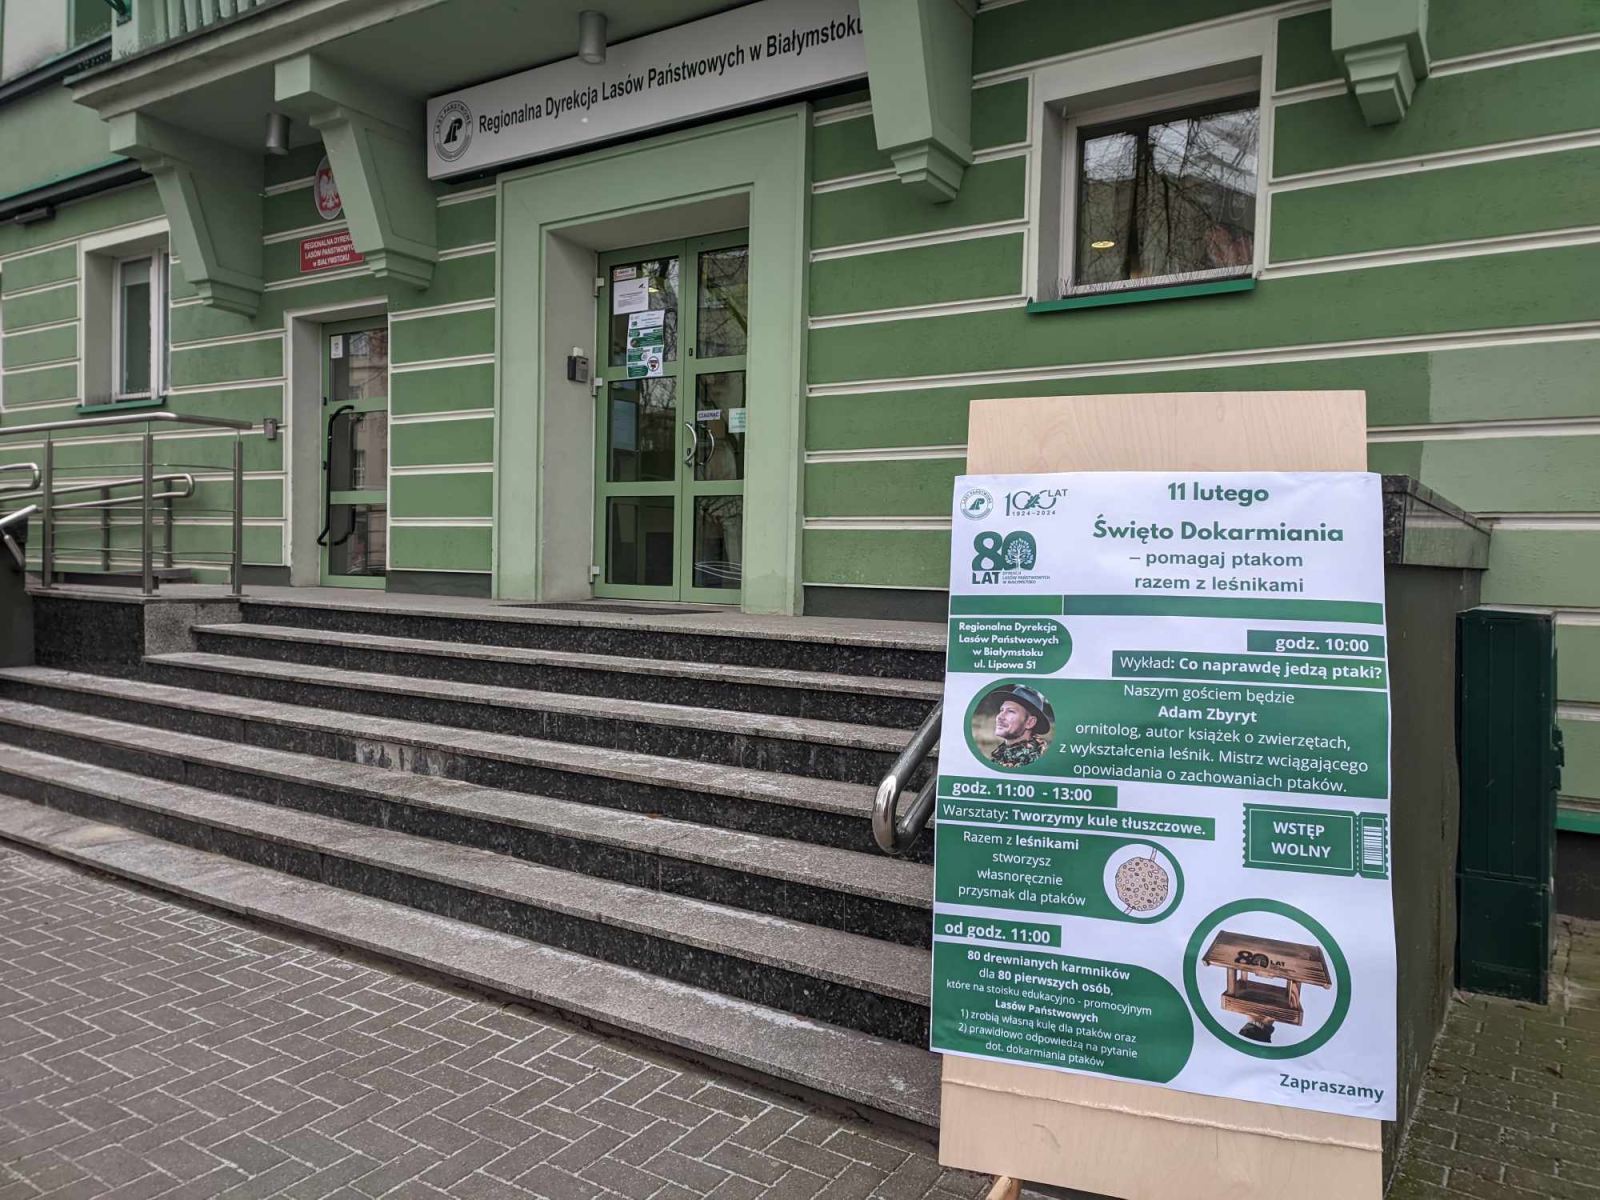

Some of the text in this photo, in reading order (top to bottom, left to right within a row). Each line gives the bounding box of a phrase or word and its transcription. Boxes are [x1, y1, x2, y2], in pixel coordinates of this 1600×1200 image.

[479, 104, 542, 134] Regionalna
[546, 86, 598, 118] Dyrekcja
[602, 73, 644, 101] Lasów
[648, 45, 744, 89] Państwowych
[749, 44, 762, 61] w
[1047, 489, 1068, 497] LAT
[1168, 482, 1269, 506] 11 lutego
[1093, 514, 1343, 543] Święto Dokarmiania
[971, 530, 1037, 571] 80
[1146, 552, 1225, 568] pomagaj
[1232, 552, 1303, 568] ptakom
[971, 572, 1000, 584] LAT
[1134, 576, 1304, 592] razem z leśnikami
[959, 621, 1057, 633] Regionalna Dyrekcja
[959, 635, 1059, 646] Lasów Państwowych
[1275, 636, 1369, 652] godz. 10:00
[984, 647, 1043, 658] Białymstoku
[974, 660, 1036, 670] ul. Lipowa 51
[1120, 656, 1382, 681] Wykład: Co naprawdę jedzą ptaki?
[1124, 685, 1295, 704] Naszym gościem będzie
[1158, 706, 1257, 724] Adam Zbyryt
[1076, 723, 1350, 751] ornitolog, autor książek o zwierzętach,
[1060, 742, 1368, 775] z wykształcenia leśnik. Mistrz wciągającego
[1074, 765, 1347, 792] opowiadania o zachowaniach ptaków.
[952, 781, 991, 796] godz.
[995, 783, 1035, 798] 11:00
[1052, 787, 1092, 801] 13:00
[943, 803, 1206, 835] Warsztaty: Tworzymy kule tłuszczowe.
[964, 831, 1079, 850] Razem z leśnikami
[1273, 821, 1325, 840] WSTĘP
[1271, 842, 1331, 858] WOLNY
[992, 853, 1051, 868] stworzysz
[977, 868, 1063, 885] własnoręcznie
[958, 886, 1086, 906] przysmak dla ptaków
[945, 922, 1051, 943] od godz. 11:00
[967, 950, 1130, 980] 80 drewnianych karmników
[979, 968, 1113, 996] dla 80 pierwszych osób,
[947, 979, 971, 990] które
[973, 984, 984, 992] na
[986, 985, 1020, 996] stoisku
[1022, 989, 1075, 1006] edukacyjno
[1084, 999, 1152, 1017] promocyjnym
[995, 999, 1099, 1023] Lasów Państwowych
[960, 1009, 1137, 1043] 1) zrobią własną kulę dla ptaków oraz
[958, 1022, 1138, 1058] 2) prawidłowo odpowiedzą na pytanie
[986, 1041, 1105, 1067] dot. dokarmiania ptaków
[1280, 1073, 1384, 1103] Zapraszamy
